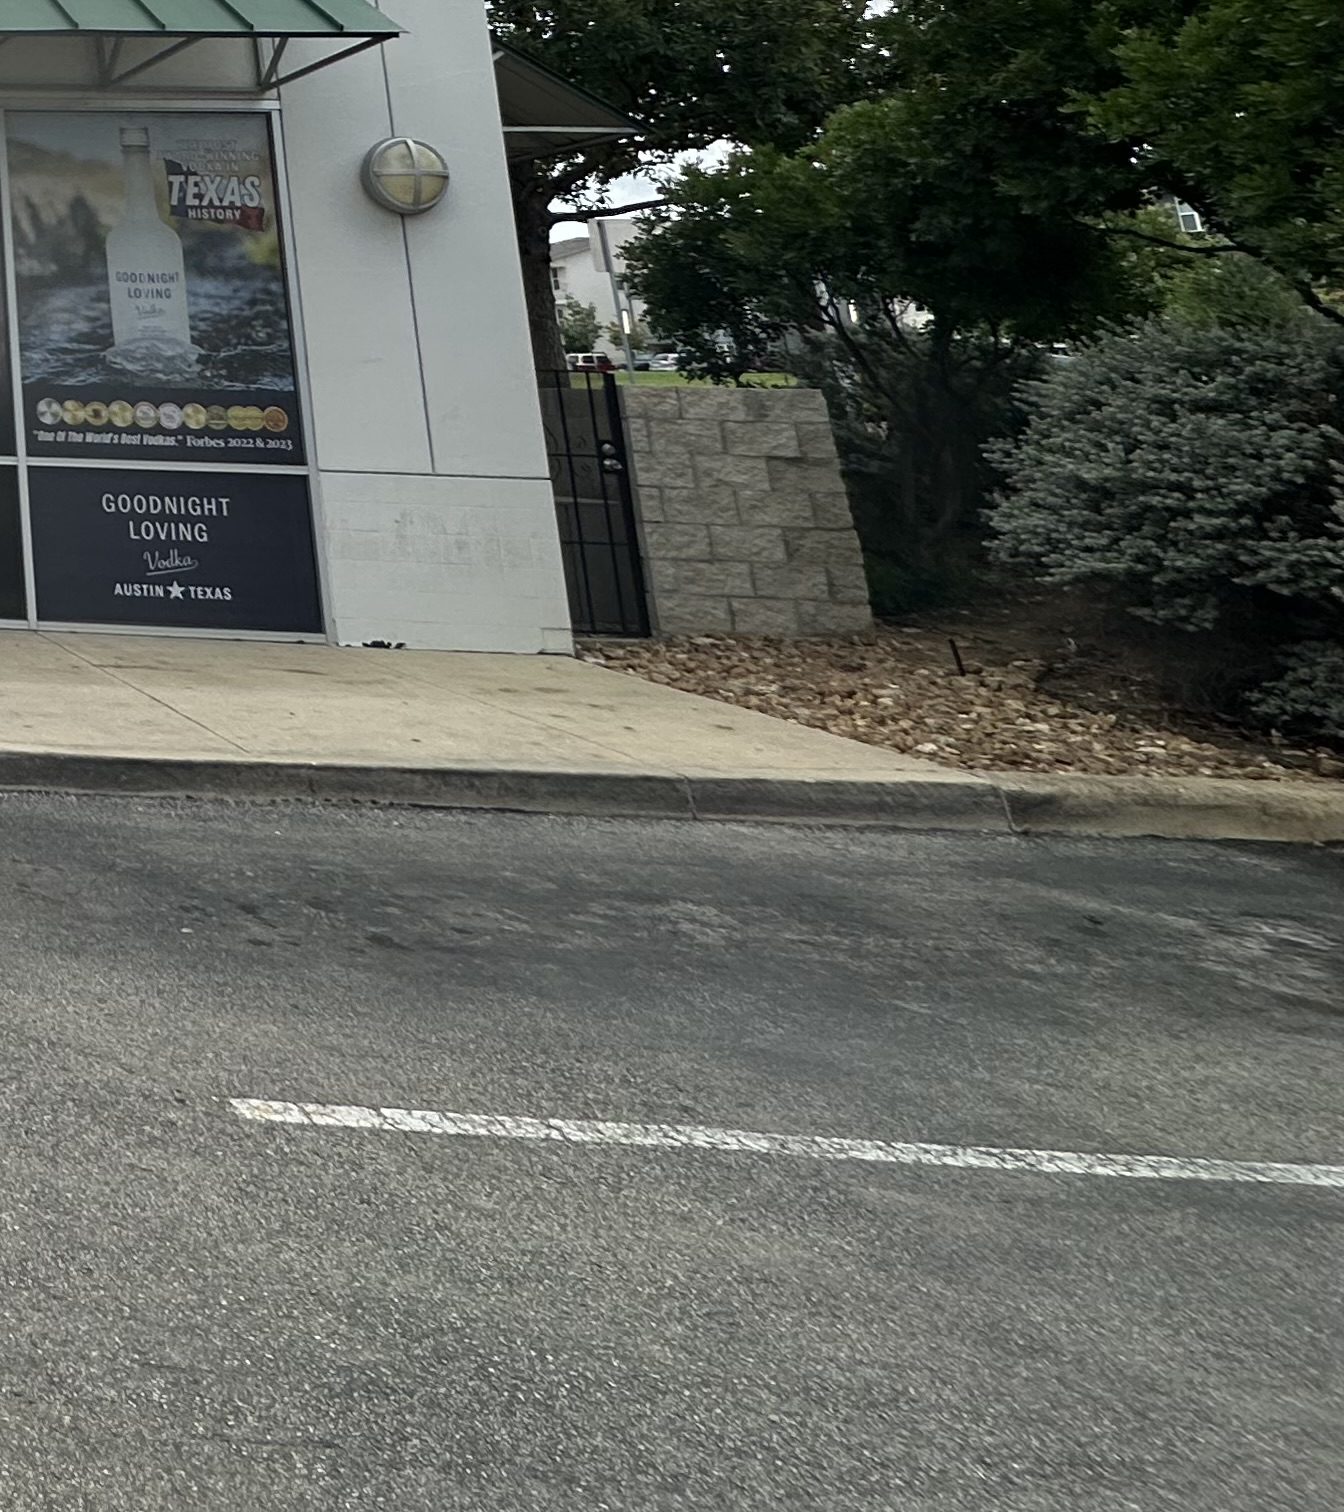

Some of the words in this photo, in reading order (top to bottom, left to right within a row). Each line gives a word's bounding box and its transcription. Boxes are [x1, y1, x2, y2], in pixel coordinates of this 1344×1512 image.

[167, 174, 261, 207] TEXAS
[188, 208, 242, 220] HISTORY
[115, 271, 179, 284] GOODNIGHT
[127, 287, 172, 299] LOVING
[186, 435, 226, 449] Forbes
[226, 438, 255, 449] 2022
[255, 438, 265, 449] &
[265, 438, 294, 451] 2023
[101, 493, 231, 517] GOODNIGHT
[128, 520, 209, 542] LOVING
[143, 548, 198, 573] Vodka
[114, 582, 164, 597] AUSTIN
[188, 585, 233, 601] TEXAS
